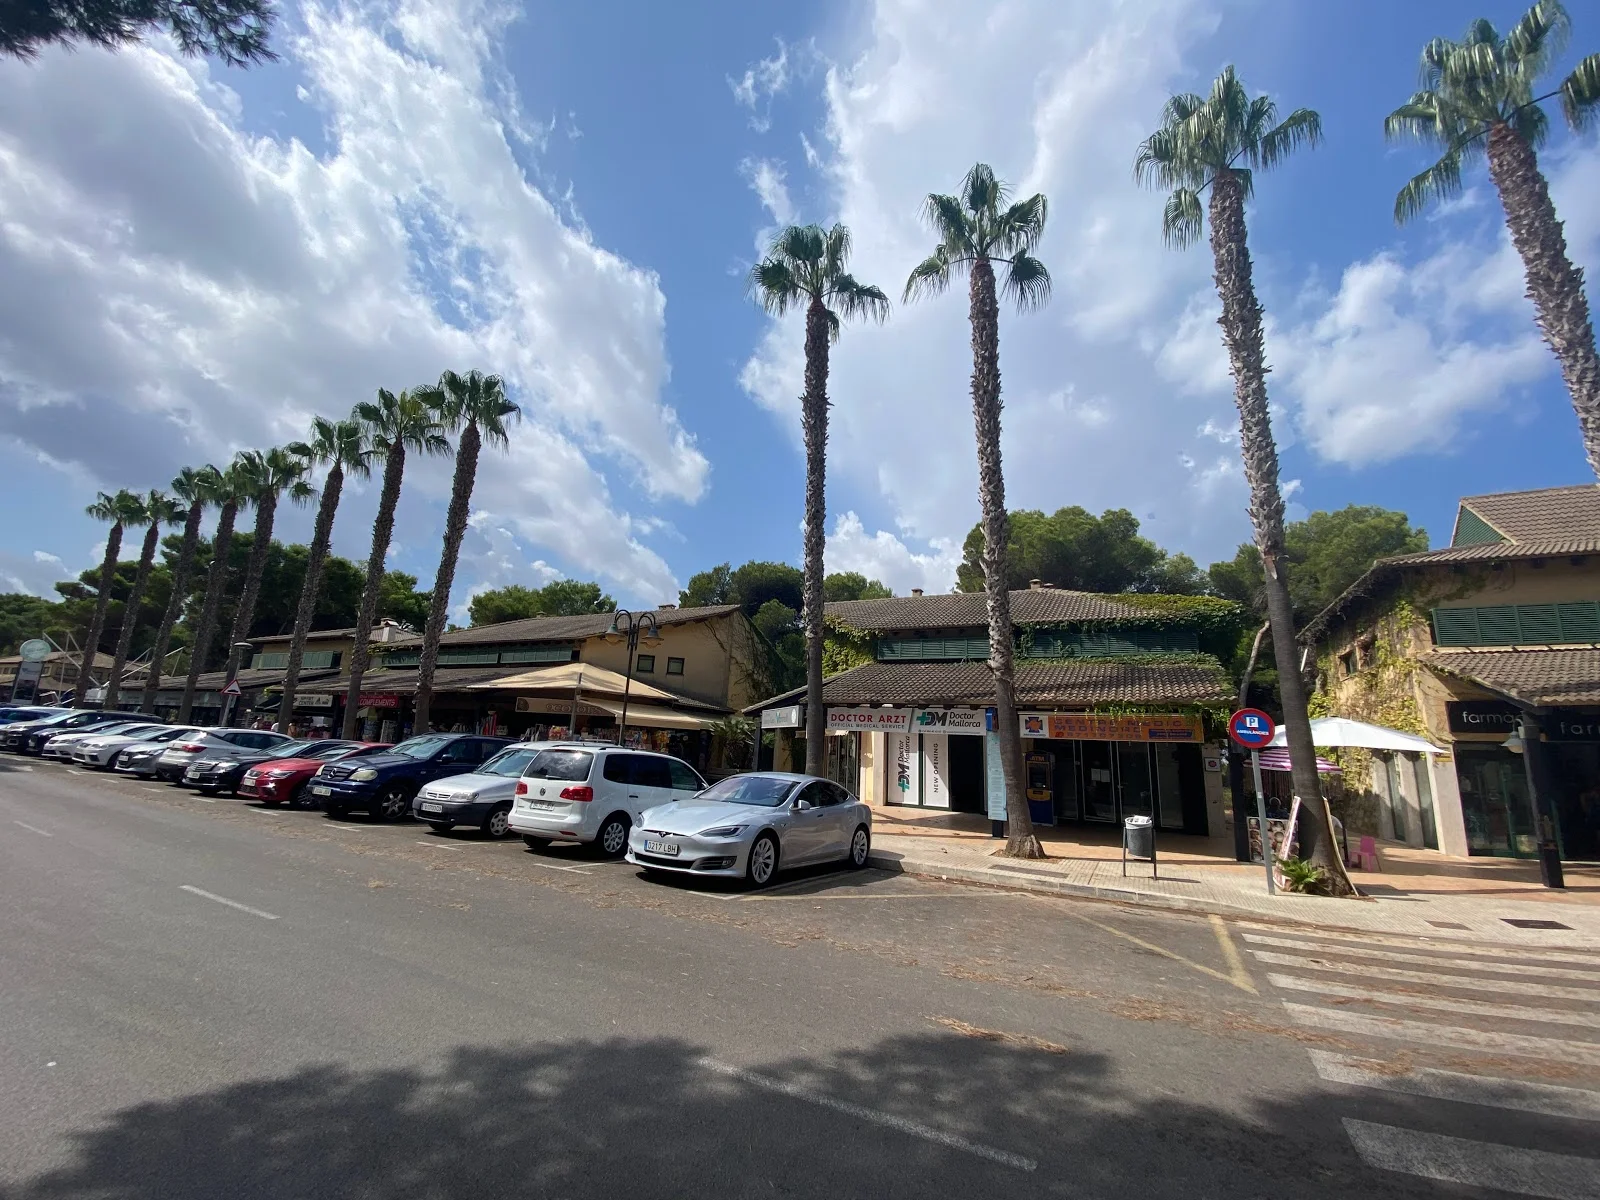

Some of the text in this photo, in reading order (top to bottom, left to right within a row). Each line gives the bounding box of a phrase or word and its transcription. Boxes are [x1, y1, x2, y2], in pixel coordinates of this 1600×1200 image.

[360, 699, 396, 707] COMPLEMENTS
[831, 713, 906, 723] DOCTOR ARZT
[949, 711, 976, 720] Doctor
[948, 720, 981, 728] Mallorca
[1249, 717, 1256, 726] P
[647, 841, 677, 854] 0217 LBH
